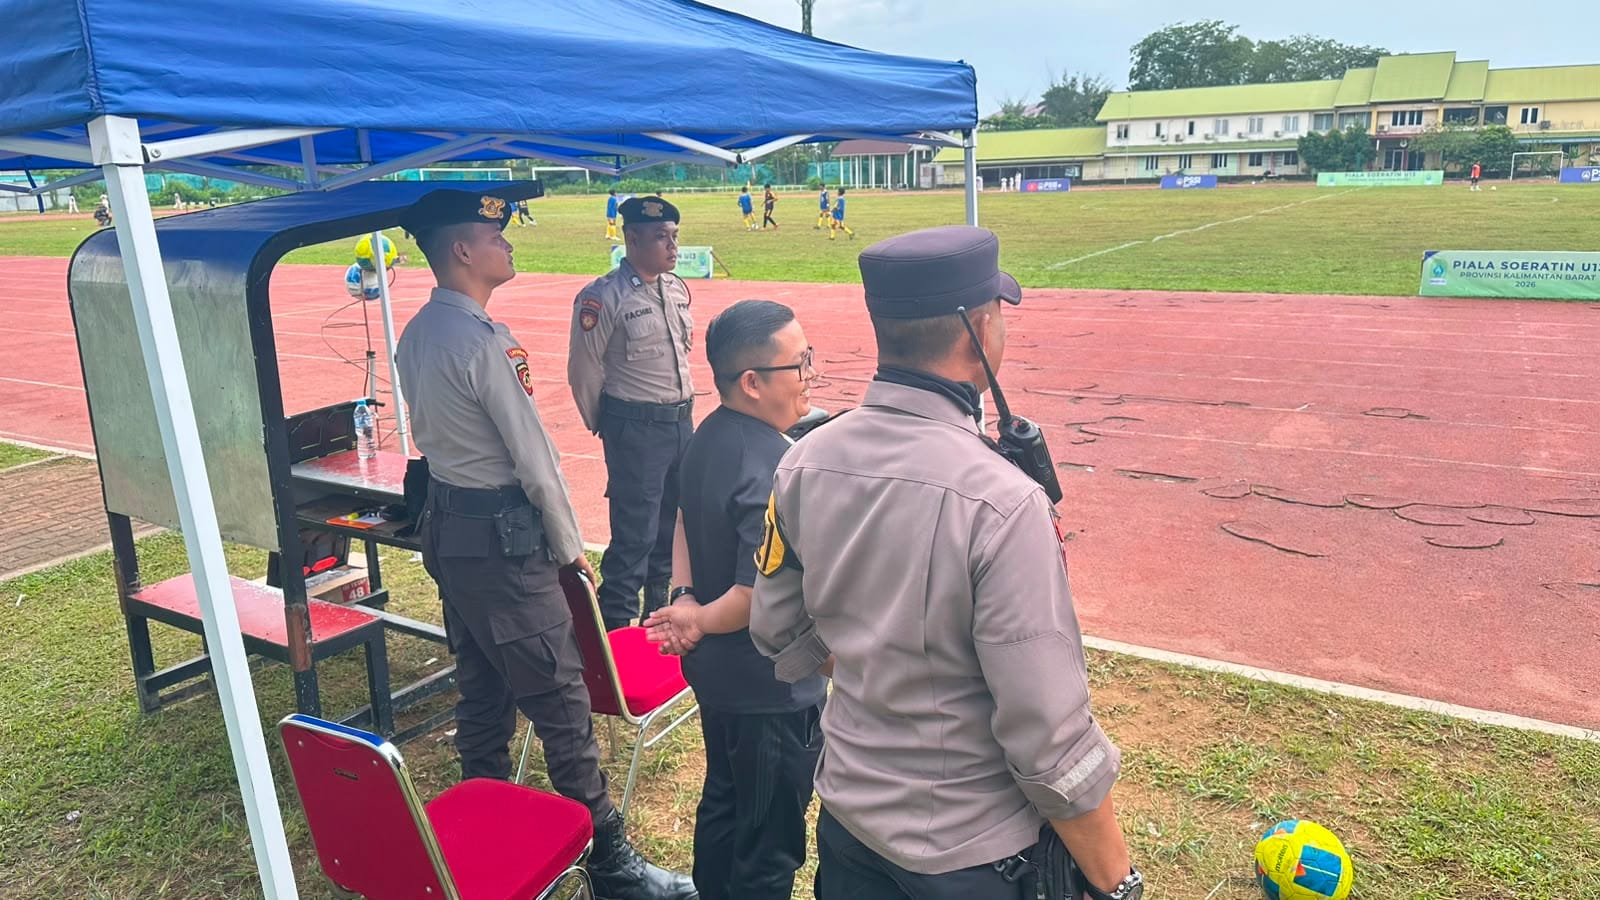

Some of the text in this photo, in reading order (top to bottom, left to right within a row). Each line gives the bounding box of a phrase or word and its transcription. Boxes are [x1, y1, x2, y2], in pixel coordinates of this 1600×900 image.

[1453, 260, 1600, 272] PIALA SOERATIN U1
[349, 586, 365, 600] 48
[1275, 844, 1288, 872] molten
